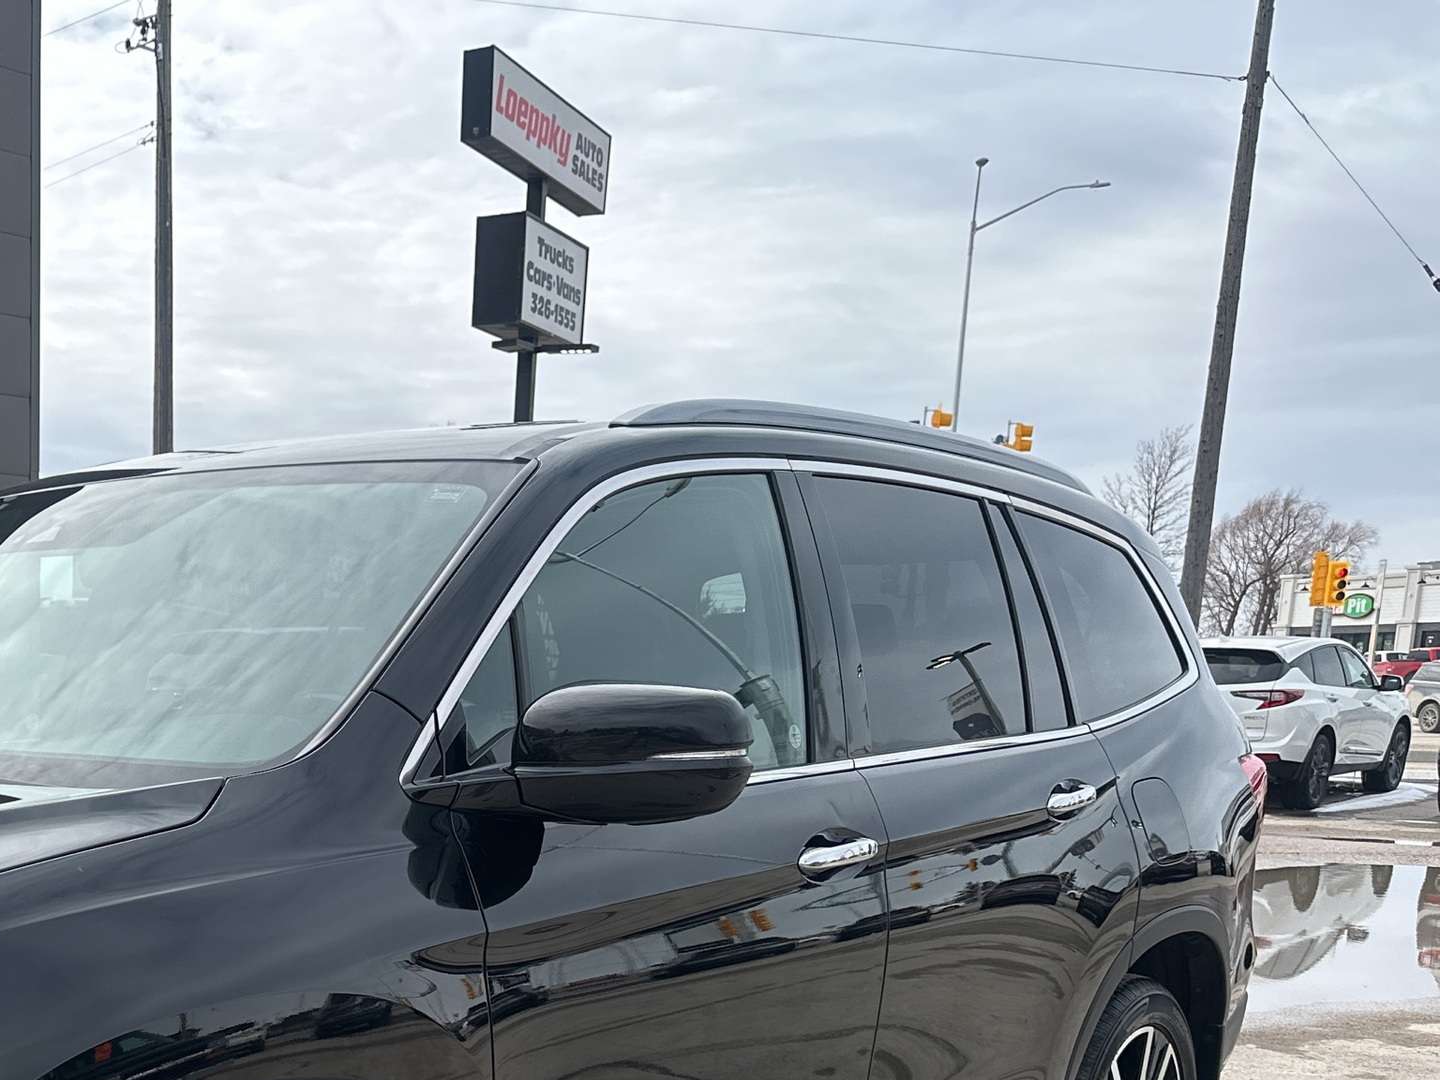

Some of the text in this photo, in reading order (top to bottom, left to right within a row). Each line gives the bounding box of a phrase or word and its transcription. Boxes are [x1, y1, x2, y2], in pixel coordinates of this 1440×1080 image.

[496, 74, 572, 167] Loeppky
[575, 132, 603, 168] AUTO
[571, 154, 604, 192] SALES
[537, 236, 574, 275] Trucks
[530, 292, 576, 331] 326-1555
[1347, 597, 1367, 613] Pit
